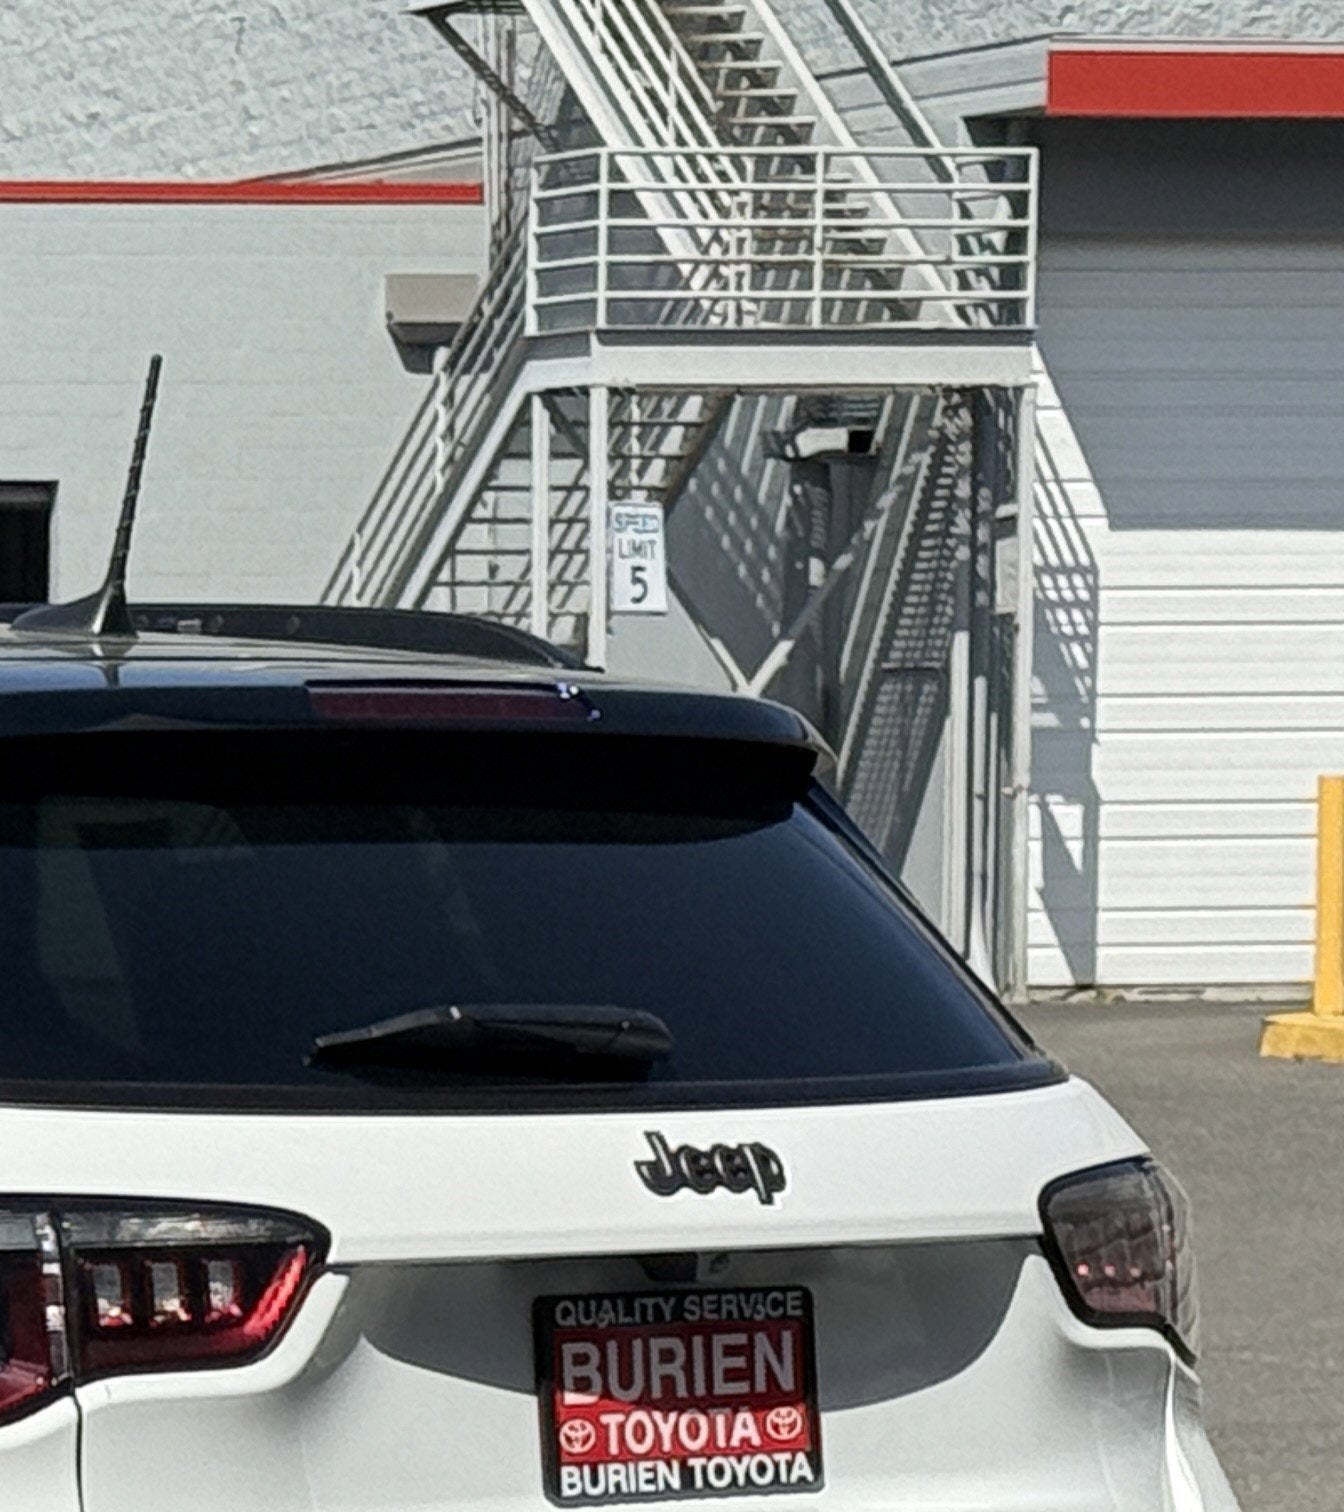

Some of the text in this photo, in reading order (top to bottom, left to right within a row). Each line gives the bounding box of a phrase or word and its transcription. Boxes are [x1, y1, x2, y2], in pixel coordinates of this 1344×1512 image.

[630, 565, 648, 604] 5
[634, 1131, 786, 1205] Jeep
[555, 1291, 804, 1327] QUALITY SERVICE
[561, 1330, 795, 1405] BURIEN
[600, 1409, 762, 1455] TOYOTA
[560, 1452, 814, 1497] BURIEN TOYOTA
